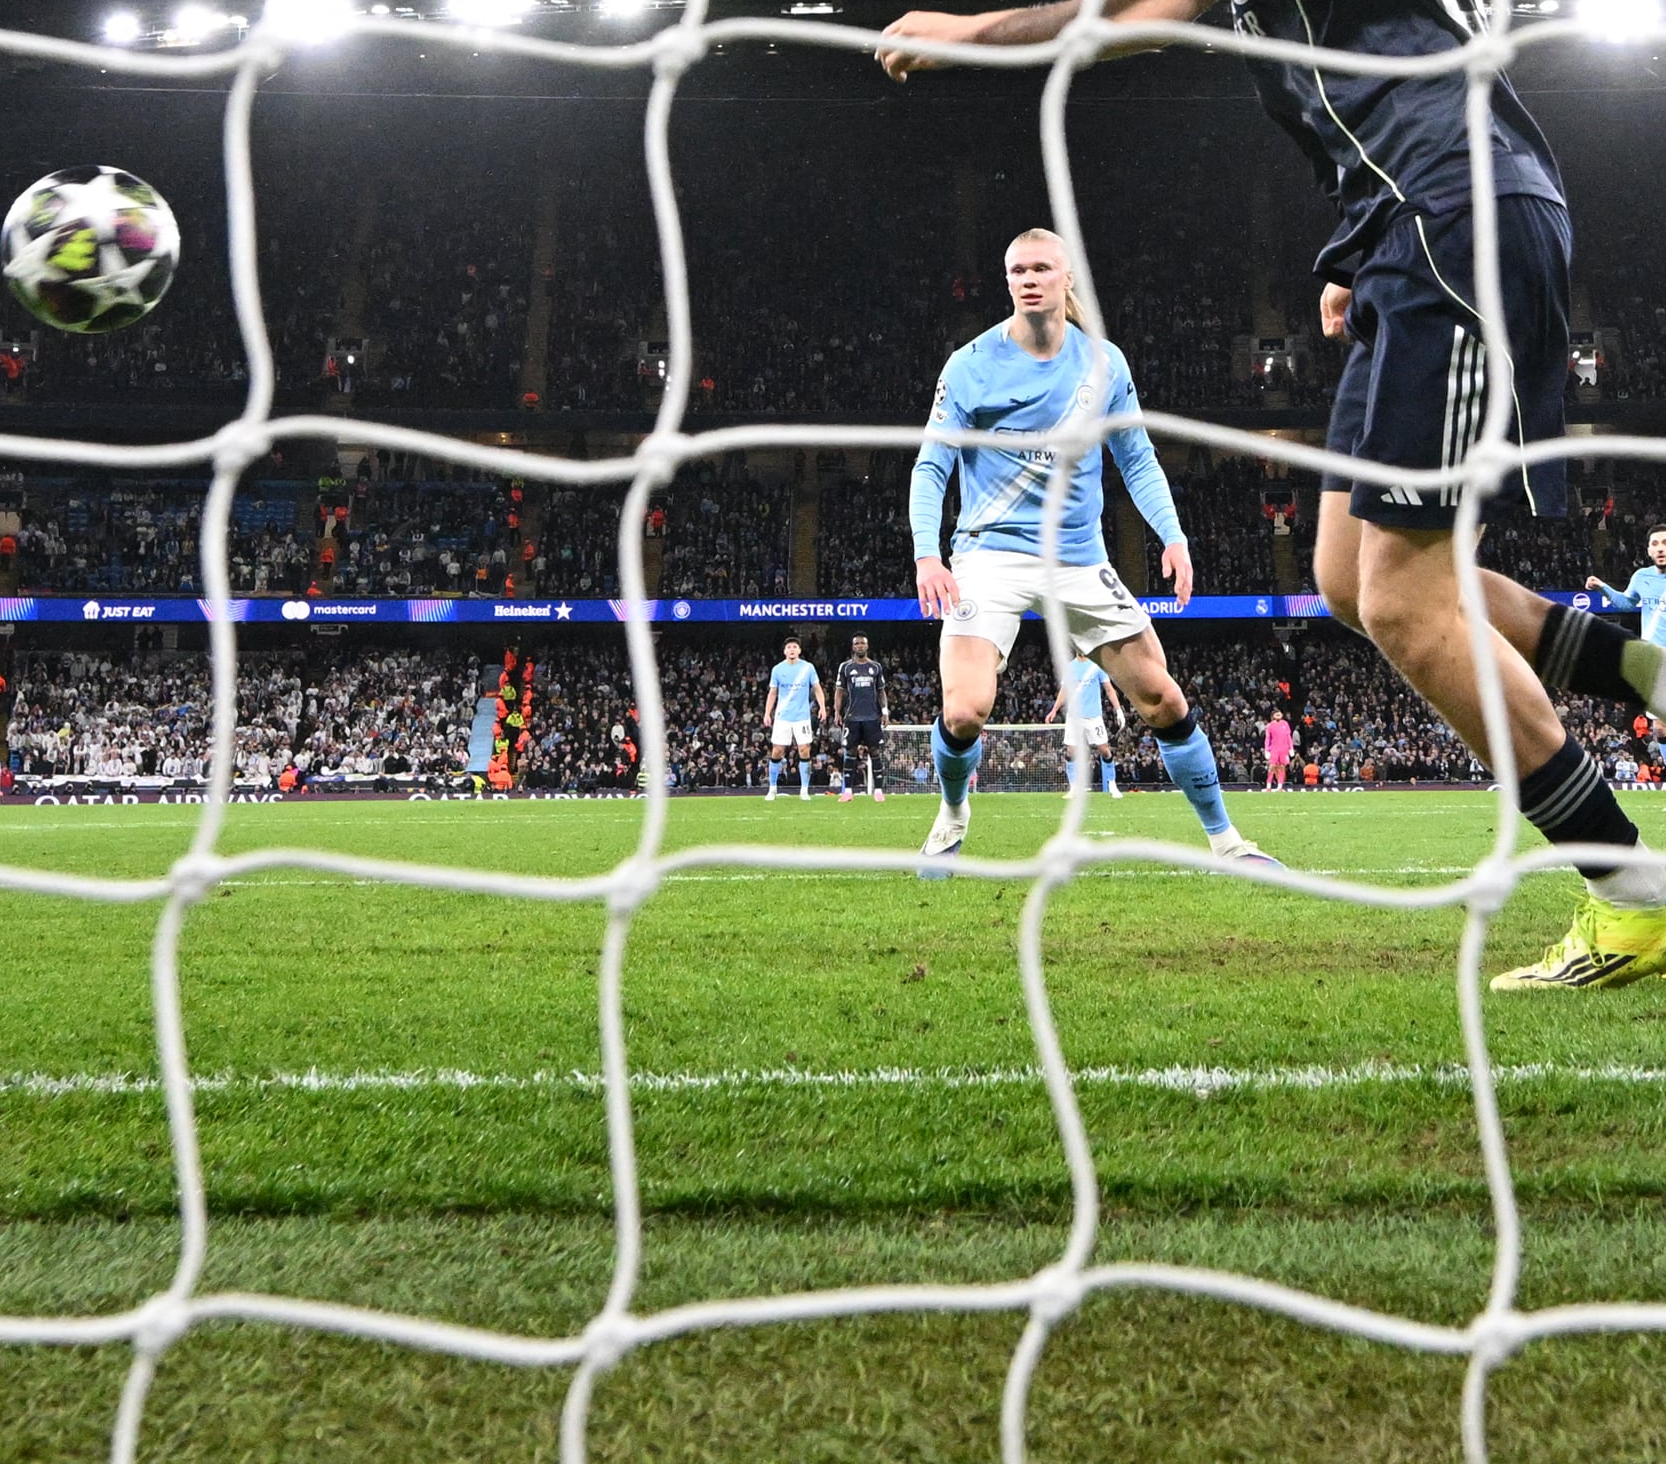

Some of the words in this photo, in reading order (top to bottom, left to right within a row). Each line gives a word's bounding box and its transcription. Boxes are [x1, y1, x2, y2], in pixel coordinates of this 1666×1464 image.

[1018, 450, 1056, 462] AIRW
[1099, 568, 1126, 600] 9
[102, 607, 130, 618] JUST
[133, 607, 155, 618] EAT
[313, 604, 377, 615] mastercard
[494, 604, 551, 617] Heineken
[740, 604, 834, 616] MANCHESTER
[837, 604, 868, 616] CITY
[1142, 601, 1183, 614] ADRID
